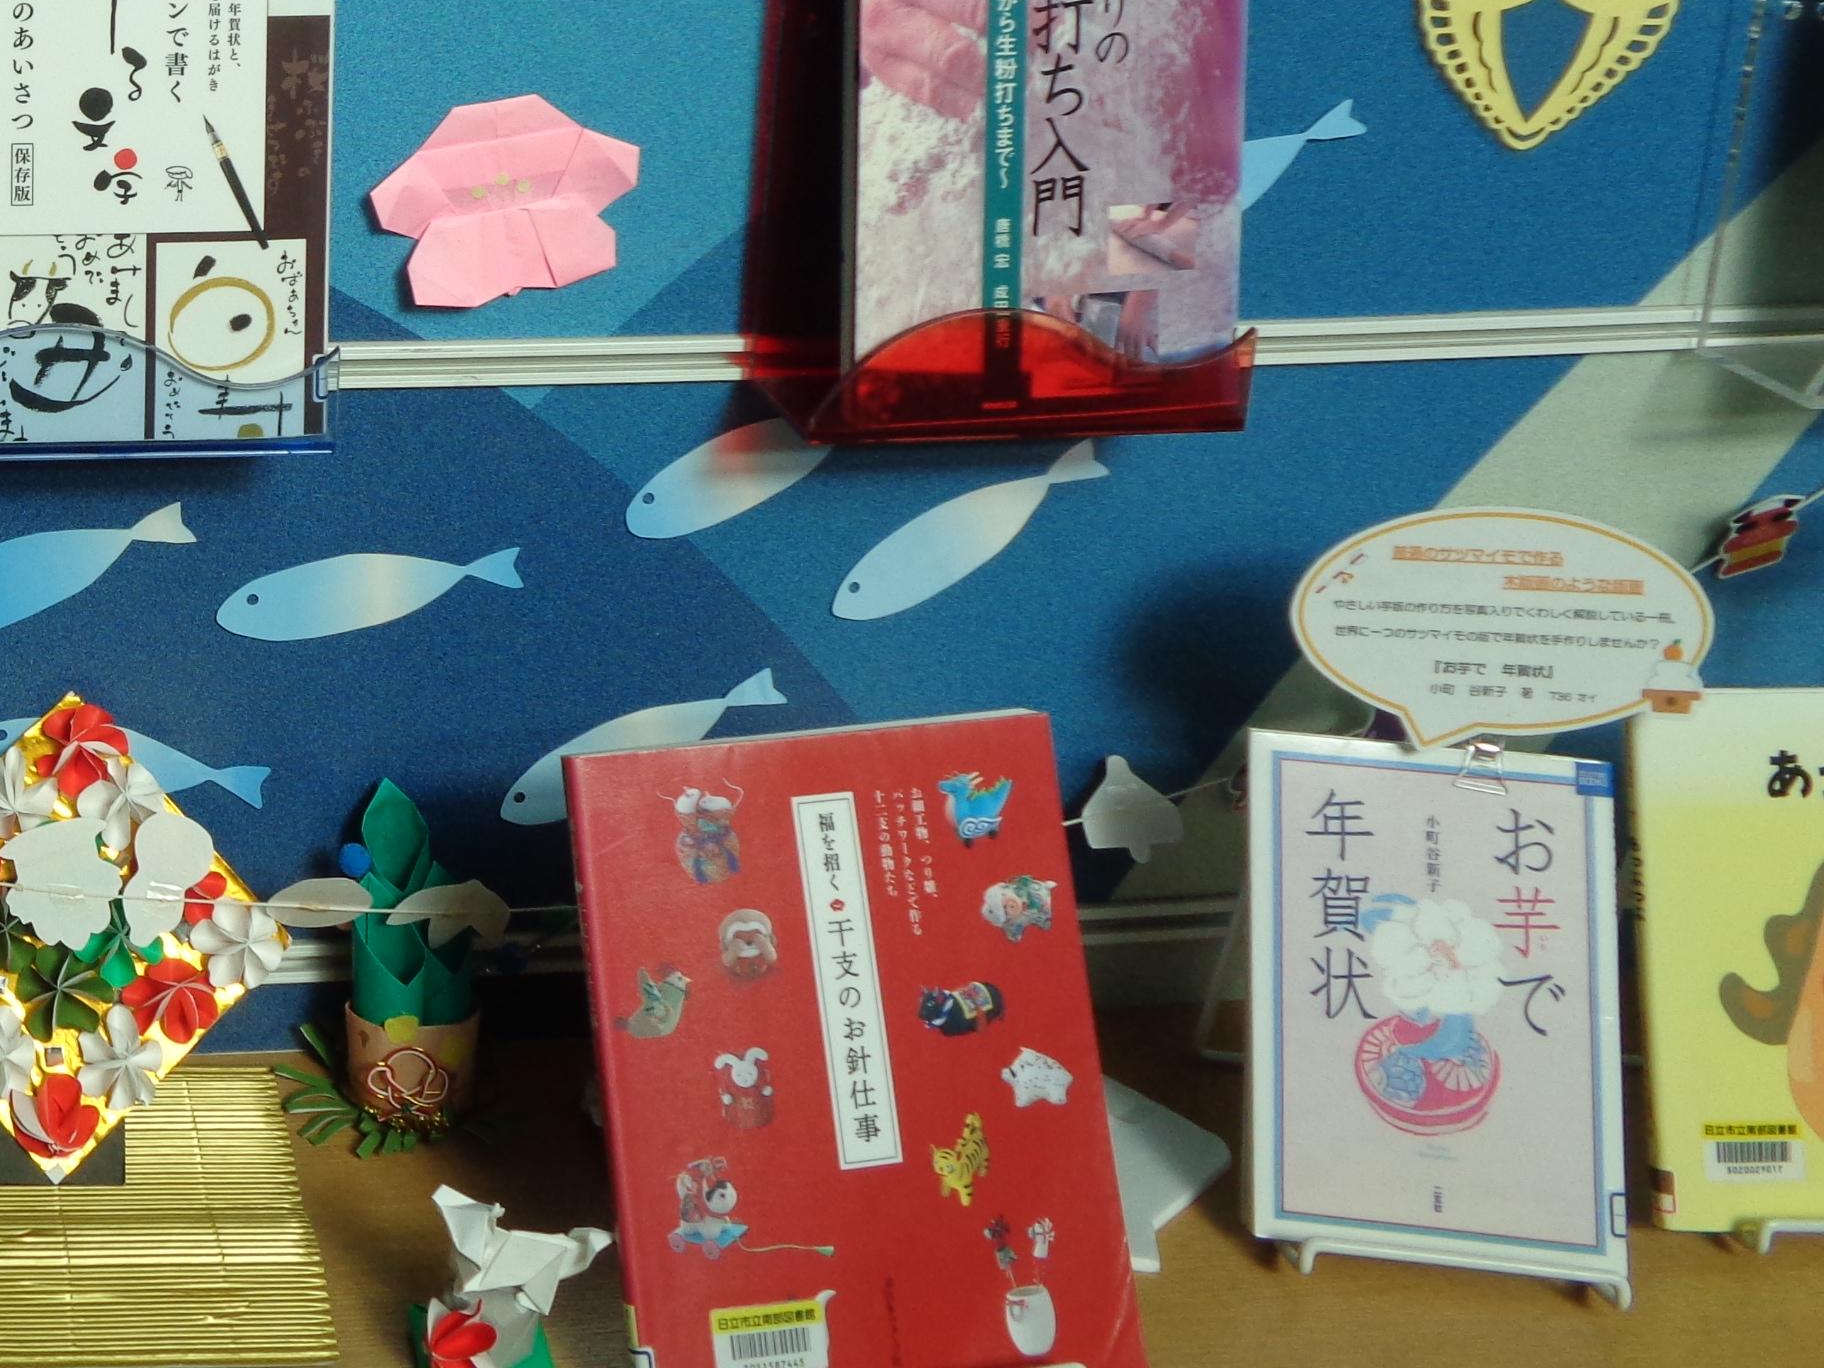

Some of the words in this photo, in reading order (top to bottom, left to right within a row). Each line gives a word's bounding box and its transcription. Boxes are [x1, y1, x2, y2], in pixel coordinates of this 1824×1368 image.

[13, 147, 33, 203] 保存版
[817, 812, 842, 892] 福を招く
[1304, 788, 1379, 1021] 年賀状
[1493, 807, 1567, 1037] お芋で
[826, 918, 882, 1143] 干支のお針仕事
